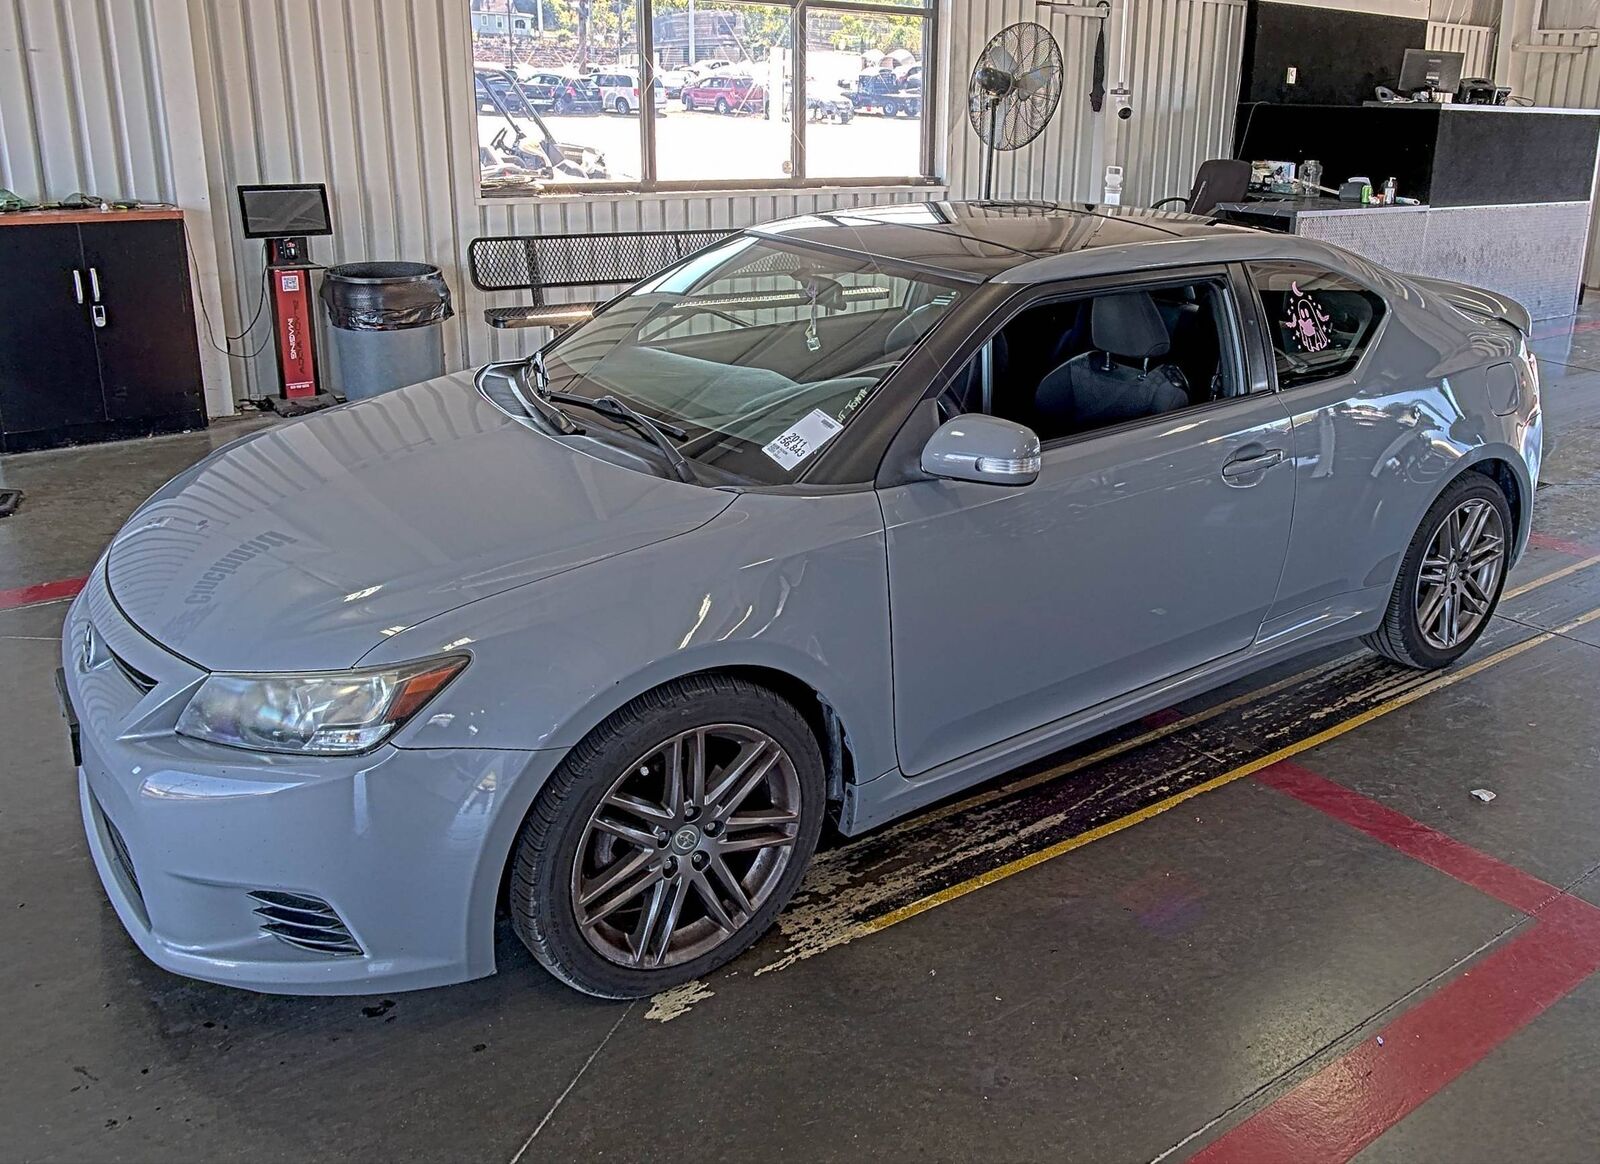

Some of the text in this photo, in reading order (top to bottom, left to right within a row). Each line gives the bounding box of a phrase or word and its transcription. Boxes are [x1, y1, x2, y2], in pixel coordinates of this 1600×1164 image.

[287, 318, 297, 360] IMAGING
[777, 436, 806, 457] 156,843
[788, 433, 807, 448] 2011
